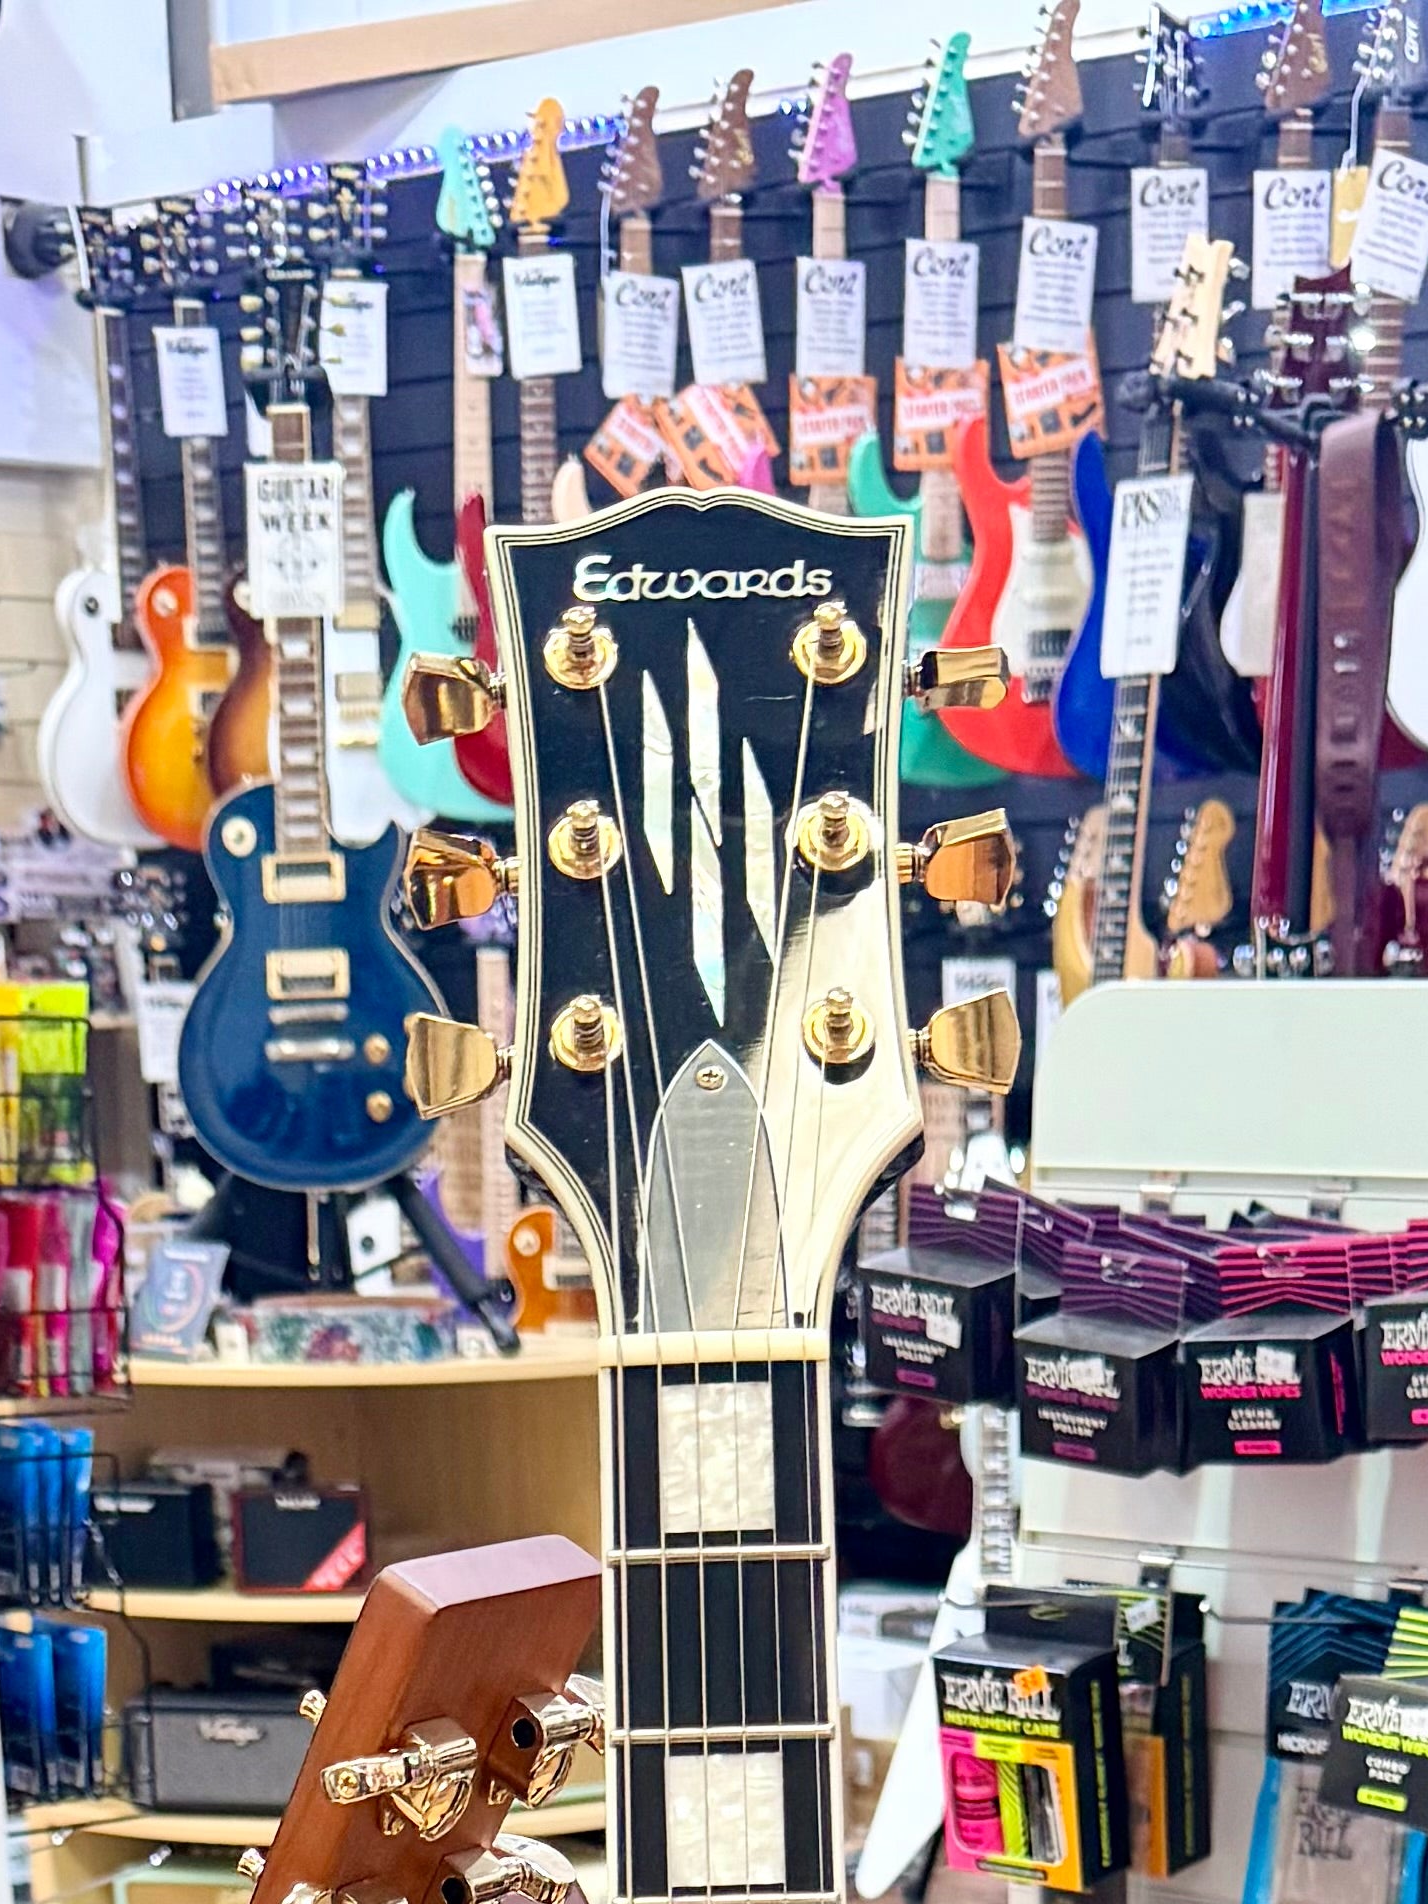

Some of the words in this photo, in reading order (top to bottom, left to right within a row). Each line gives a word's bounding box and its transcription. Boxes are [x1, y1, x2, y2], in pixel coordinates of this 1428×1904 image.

[1138, 175, 1199, 209] Cort
[1263, 179, 1325, 211] Cort
[259, 513, 331, 531] WEEK
[574, 554, 833, 602] Edwards
[940, 1668, 1005, 1715] ERNIE
[1286, 1680, 1334, 1721] ERN
[943, 1708, 1020, 1734] INSTRUMENT
[1022, 1720, 1062, 1739] CARE
[1341, 1724, 1400, 1751] WONDER
